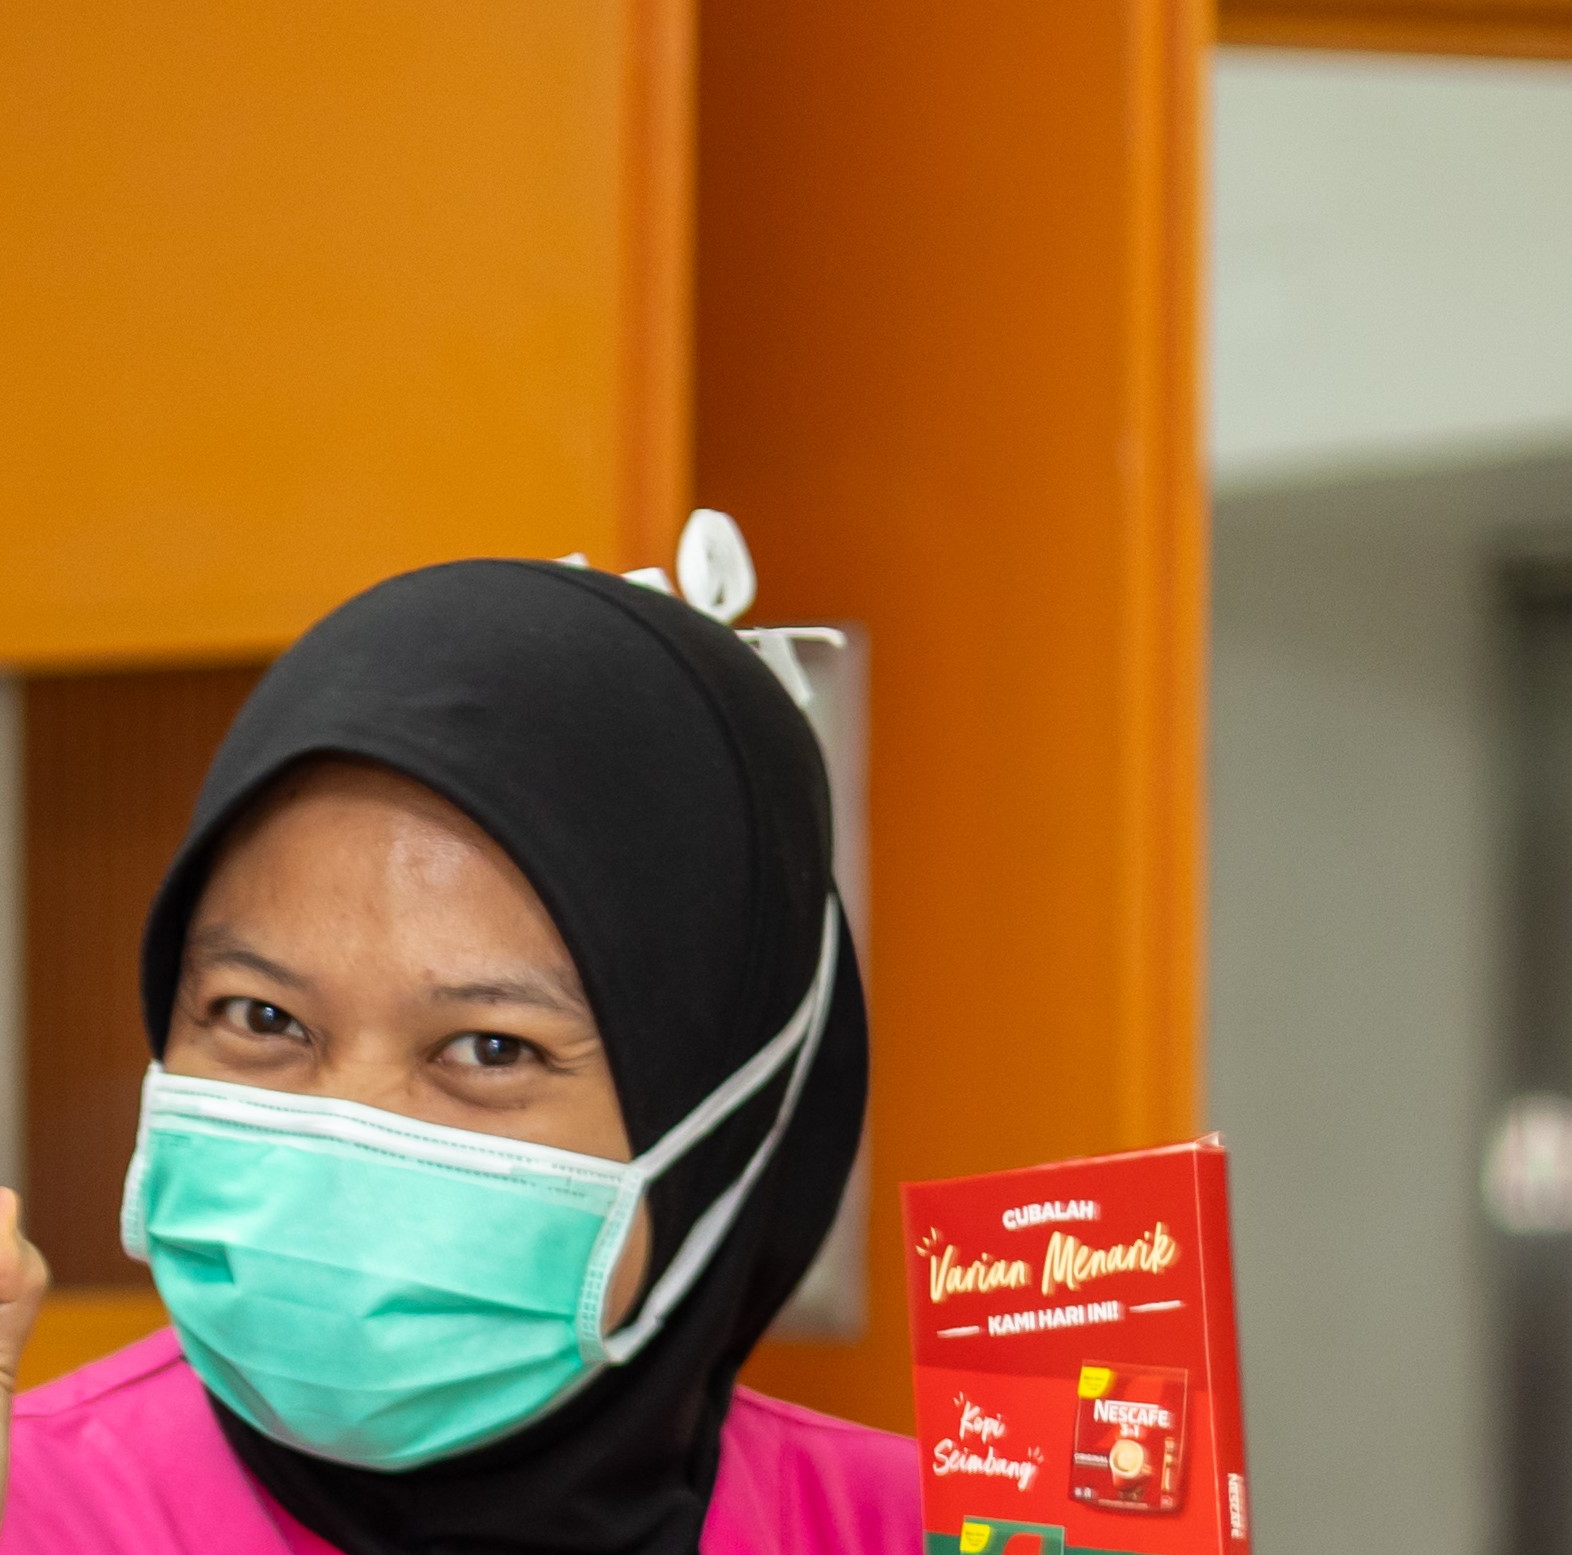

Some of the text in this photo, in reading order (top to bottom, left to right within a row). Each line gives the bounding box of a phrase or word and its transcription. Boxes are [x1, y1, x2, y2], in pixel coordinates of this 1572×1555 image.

[1002, 1200, 1097, 1231] CUBALAH
[930, 1222, 1178, 1303] Varian Menarik
[988, 1301, 1122, 1336] KAMI HARI INI!
[959, 1401, 1006, 1444] Kopi
[933, 1438, 1037, 1491] Seimbang
